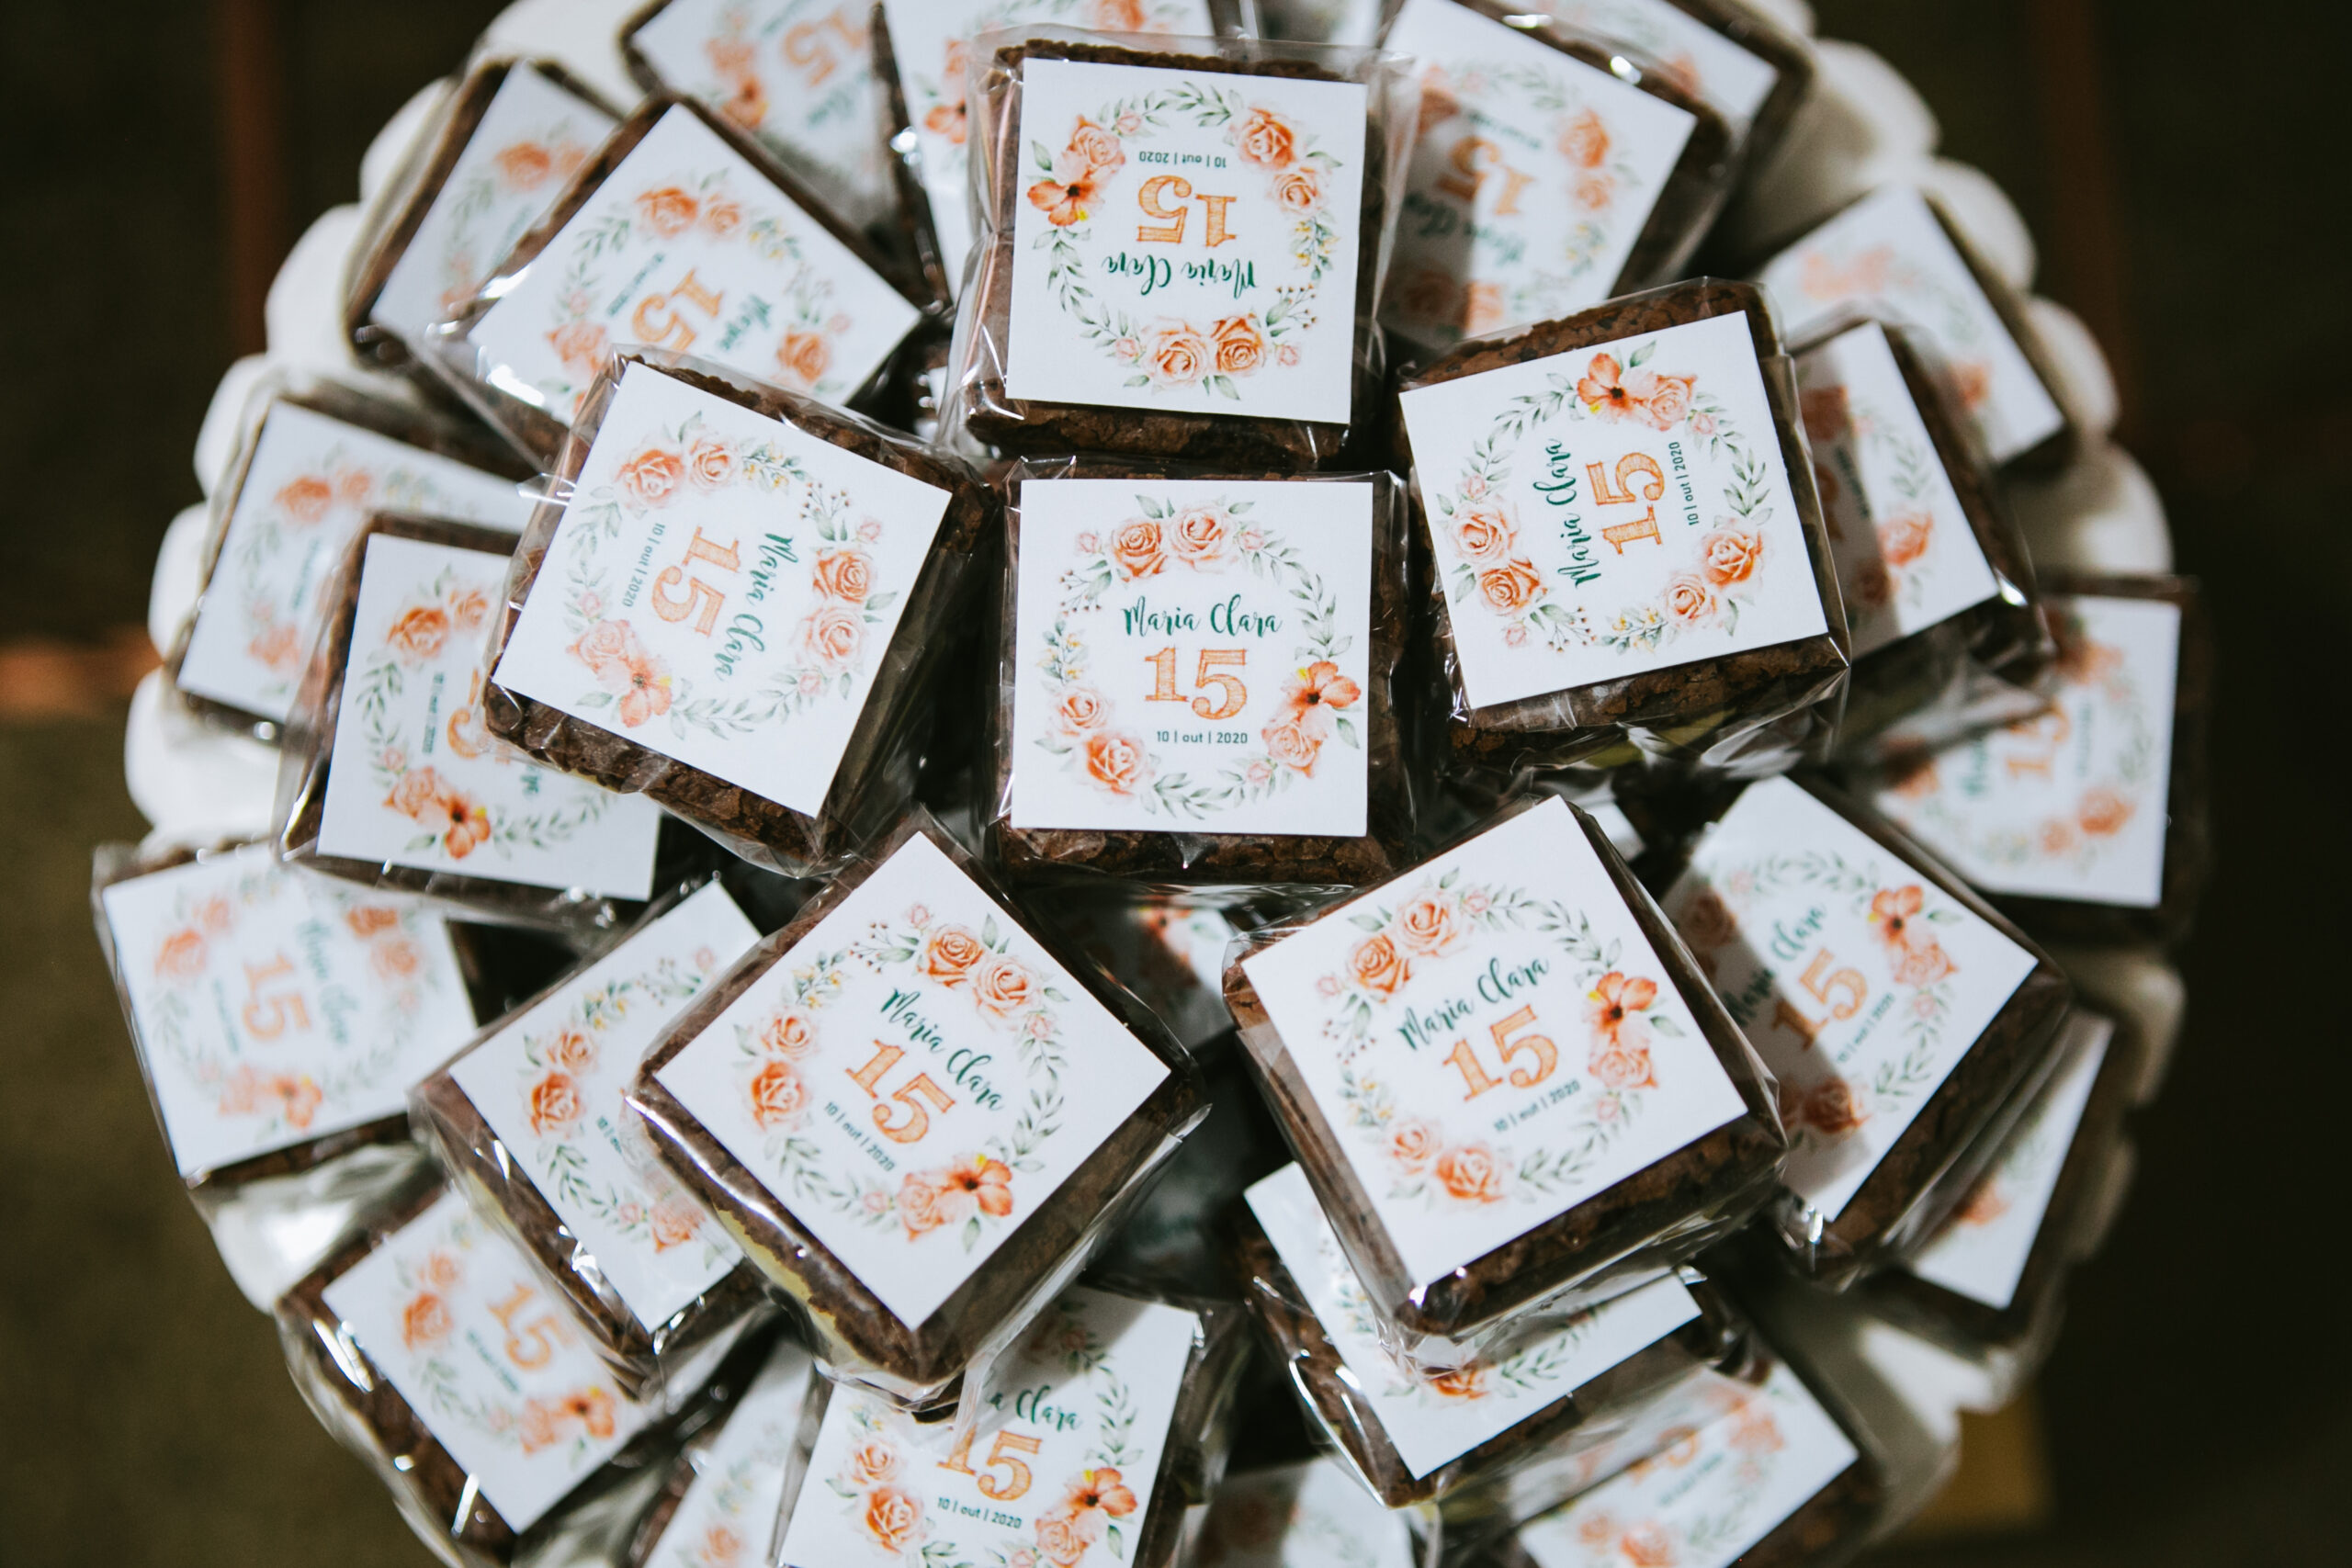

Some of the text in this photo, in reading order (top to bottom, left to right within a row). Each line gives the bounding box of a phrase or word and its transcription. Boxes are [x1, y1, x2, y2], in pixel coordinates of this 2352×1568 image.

[1139, 151, 1170, 164] 2020
[1182, 153, 1203, 164] out
[1214, 156, 1227, 168] 10
[1436, 135, 1538, 217] 15
[1136, 175, 1237, 248] 15
[1102, 252, 1259, 299] Maria Clara
[632, 266, 725, 364] 15
[1668, 441, 1687, 471] 2020
[1532, 438, 1601, 589] Maria Clara
[1586, 452, 1665, 556] 15
[1679, 482, 1694, 502] out
[1687, 513, 1700, 525] 10
[639, 546, 653, 567] out
[652, 523, 666, 536] 10
[622, 575, 643, 607] 2020
[651, 526, 741, 637] 15
[714, 533, 798, 682] Maria Clara
[1120, 593, 1283, 637] Maria Clara
[1145, 645, 1248, 720] 15
[1157, 731, 1169, 742] 10
[1182, 732, 1203, 743] out
[1216, 732, 1248, 744] 2020
[1771, 905, 1827, 962] Clara
[243, 947, 312, 1043] 15
[1396, 957, 1549, 1051] Maria Clara
[1771, 947, 1868, 1052] 15
[880, 988, 1006, 1111] Maria Clara
[1442, 1003, 1558, 1102] 15
[844, 1039, 956, 1144] 15
[824, 1101, 839, 1117] 10
[842, 1122, 862, 1141] out
[866, 1145, 896, 1172] 2020
[487, 1281, 578, 1370] 15
[1015, 1384, 1082, 1432] Clara
[937, 1496, 950, 1509] 10
[960, 1505, 981, 1519] out
[991, 1512, 1023, 1529] 2020
